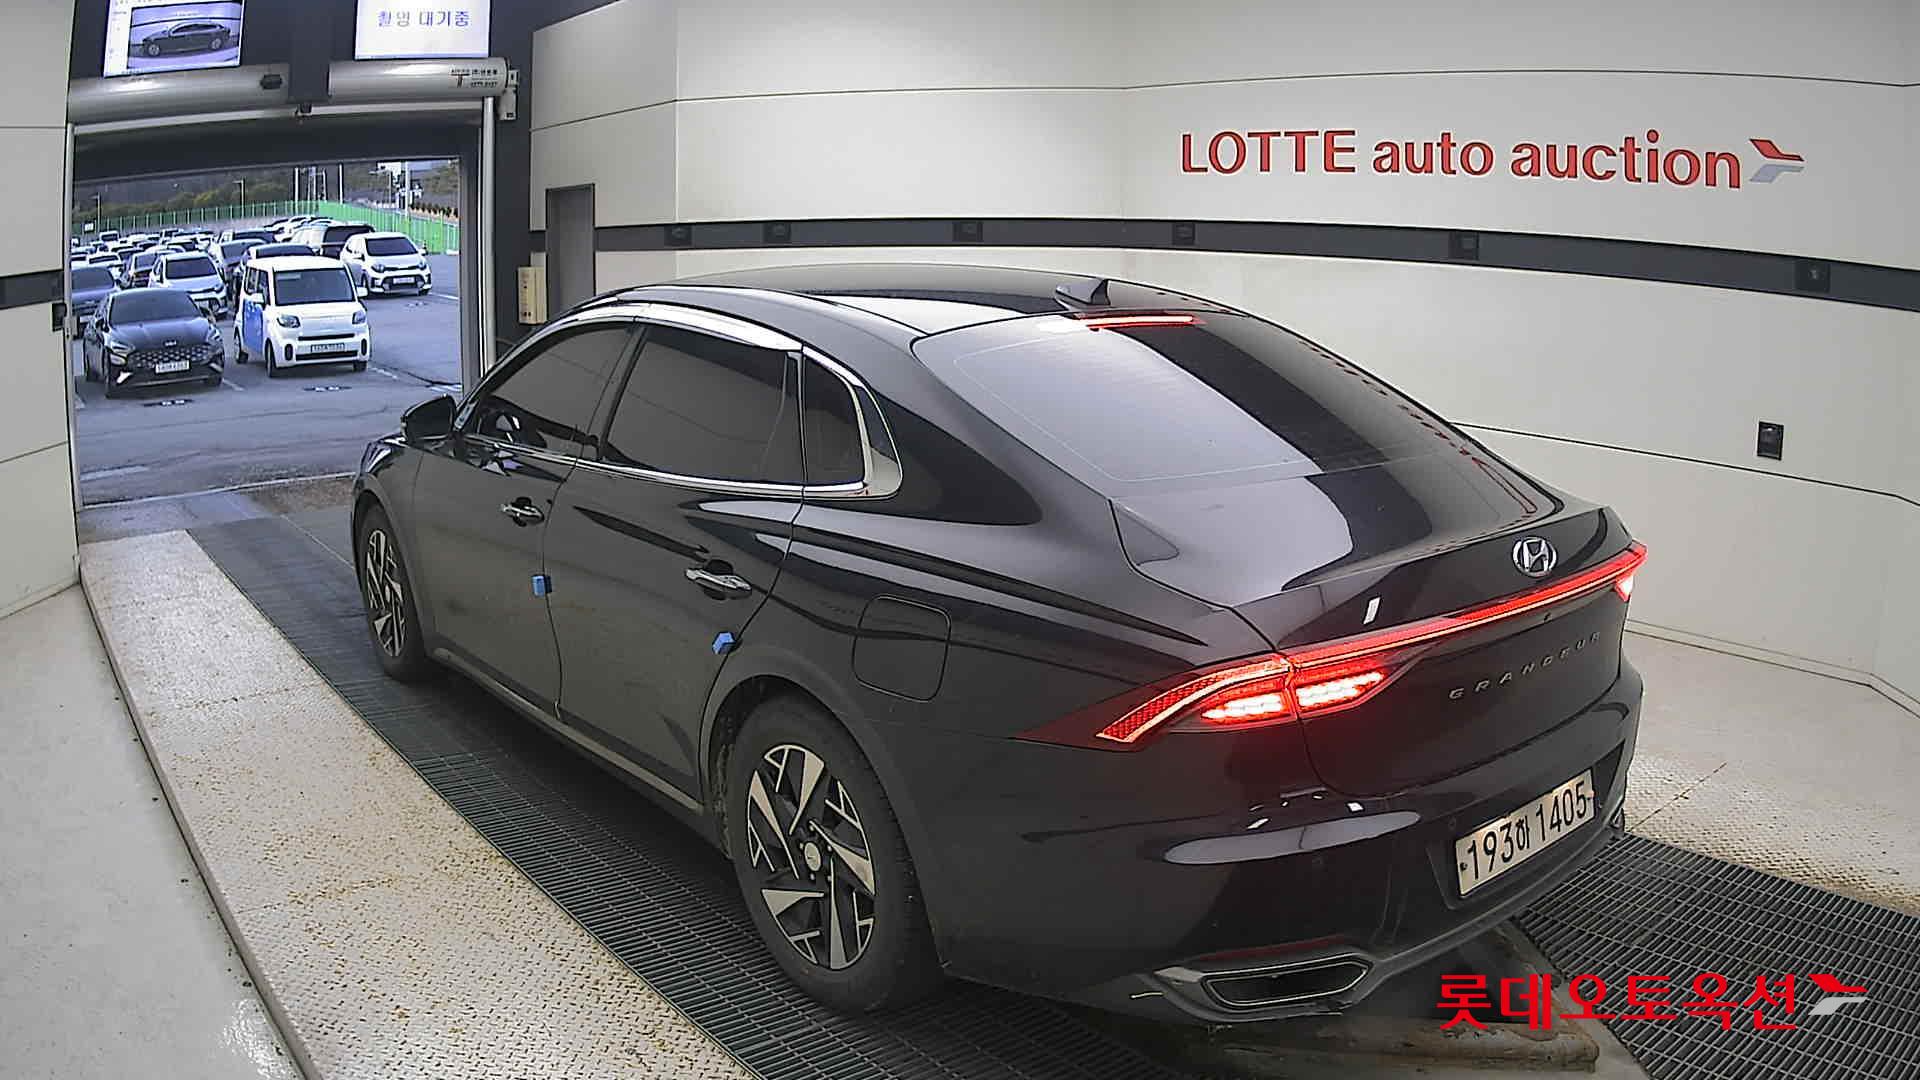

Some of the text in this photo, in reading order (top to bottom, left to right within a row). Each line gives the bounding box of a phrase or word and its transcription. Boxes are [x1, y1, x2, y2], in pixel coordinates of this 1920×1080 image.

[419, 11, 469, 27] 대기중
[1181, 129, 1741, 190] LOTTE auto auction
[1449, 631, 1601, 699] GRANDEUR
[1467, 780, 1587, 880] 193하 1405
